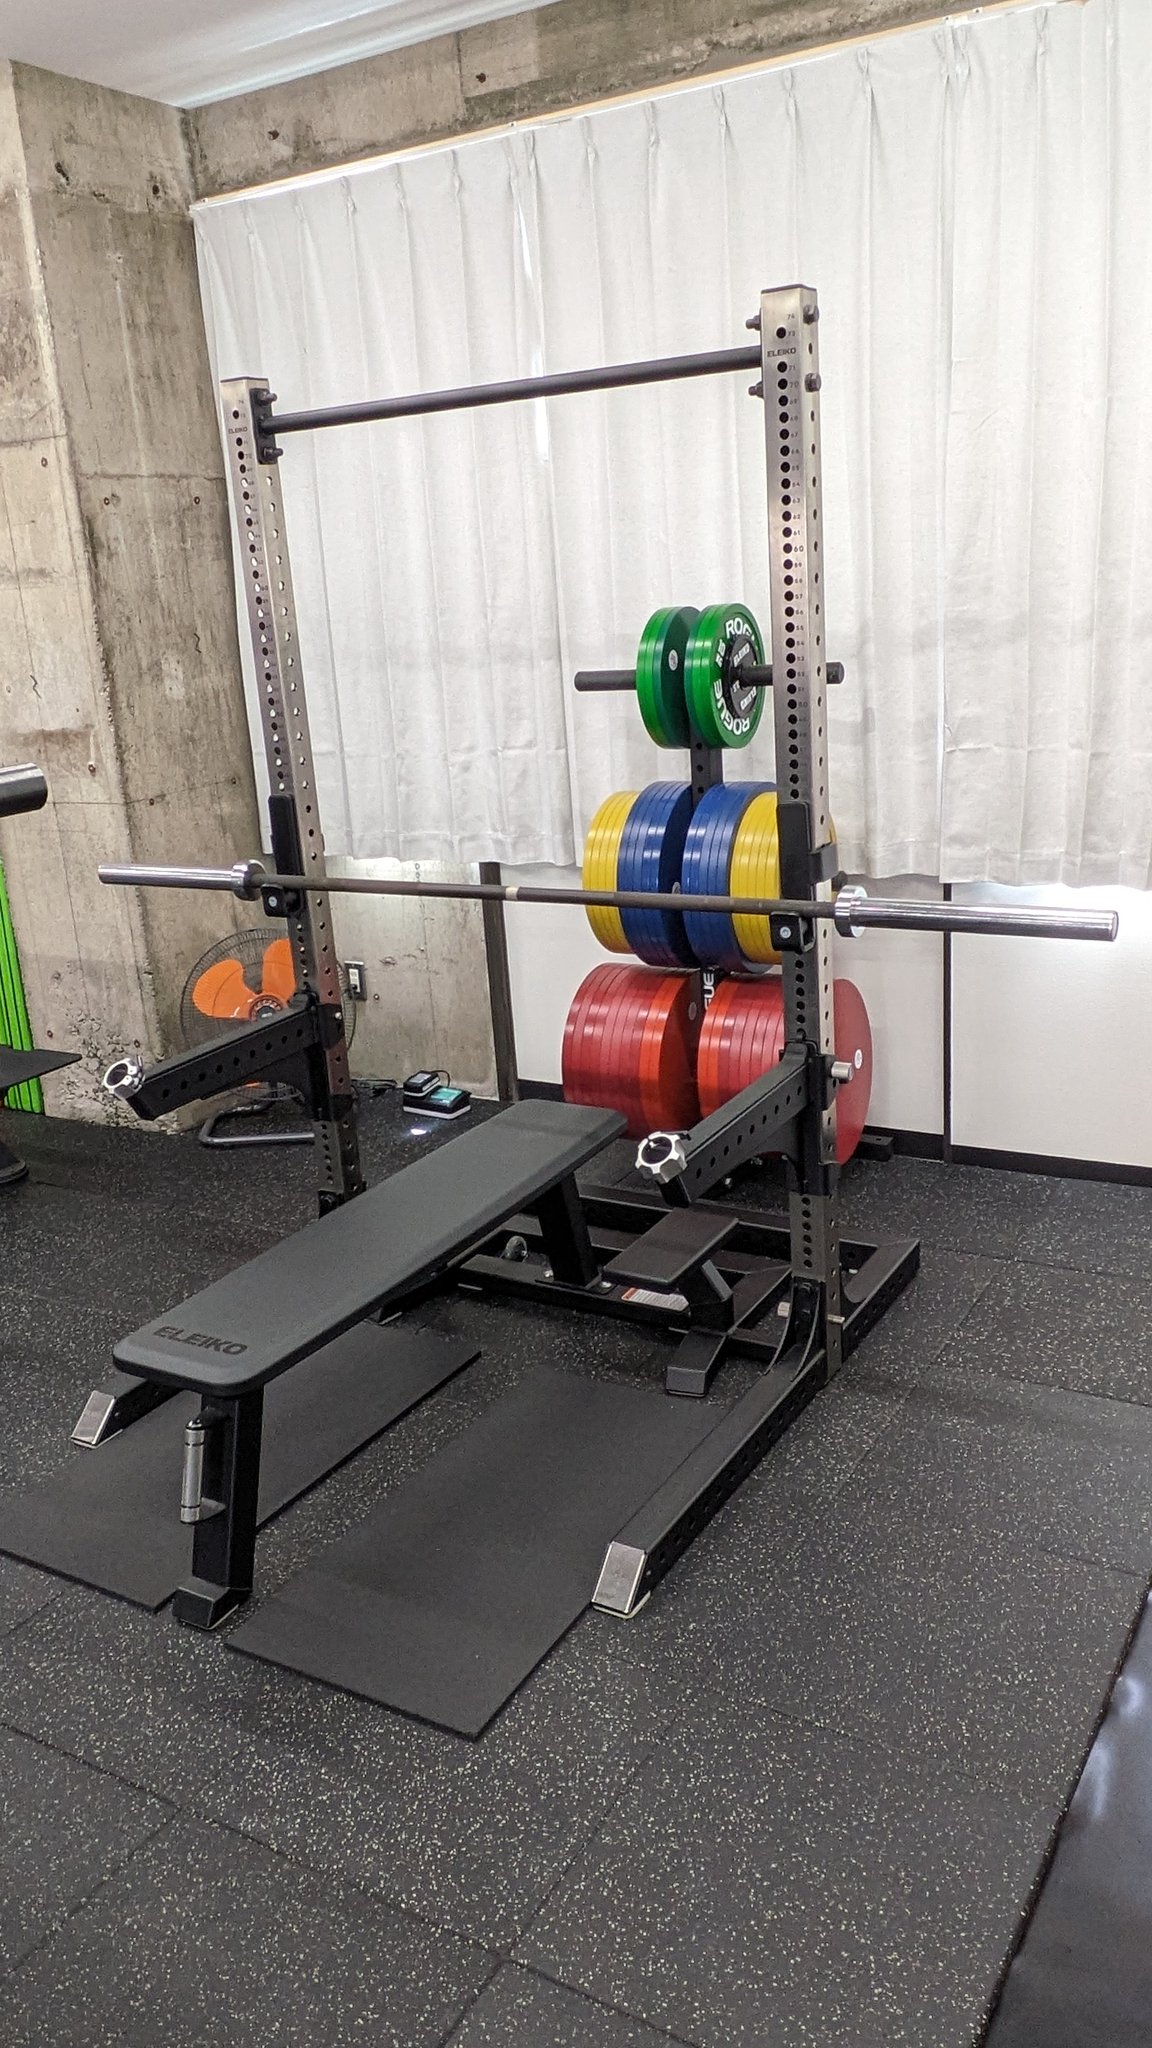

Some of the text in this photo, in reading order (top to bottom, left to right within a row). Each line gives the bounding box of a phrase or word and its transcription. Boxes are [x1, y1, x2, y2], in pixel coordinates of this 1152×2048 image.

[767, 347, 797, 357] ELEIKO
[793, 545, 804, 553] 60
[713, 678, 750, 735] ROGUE
[153, 1326, 248, 1355] ELEIKO
